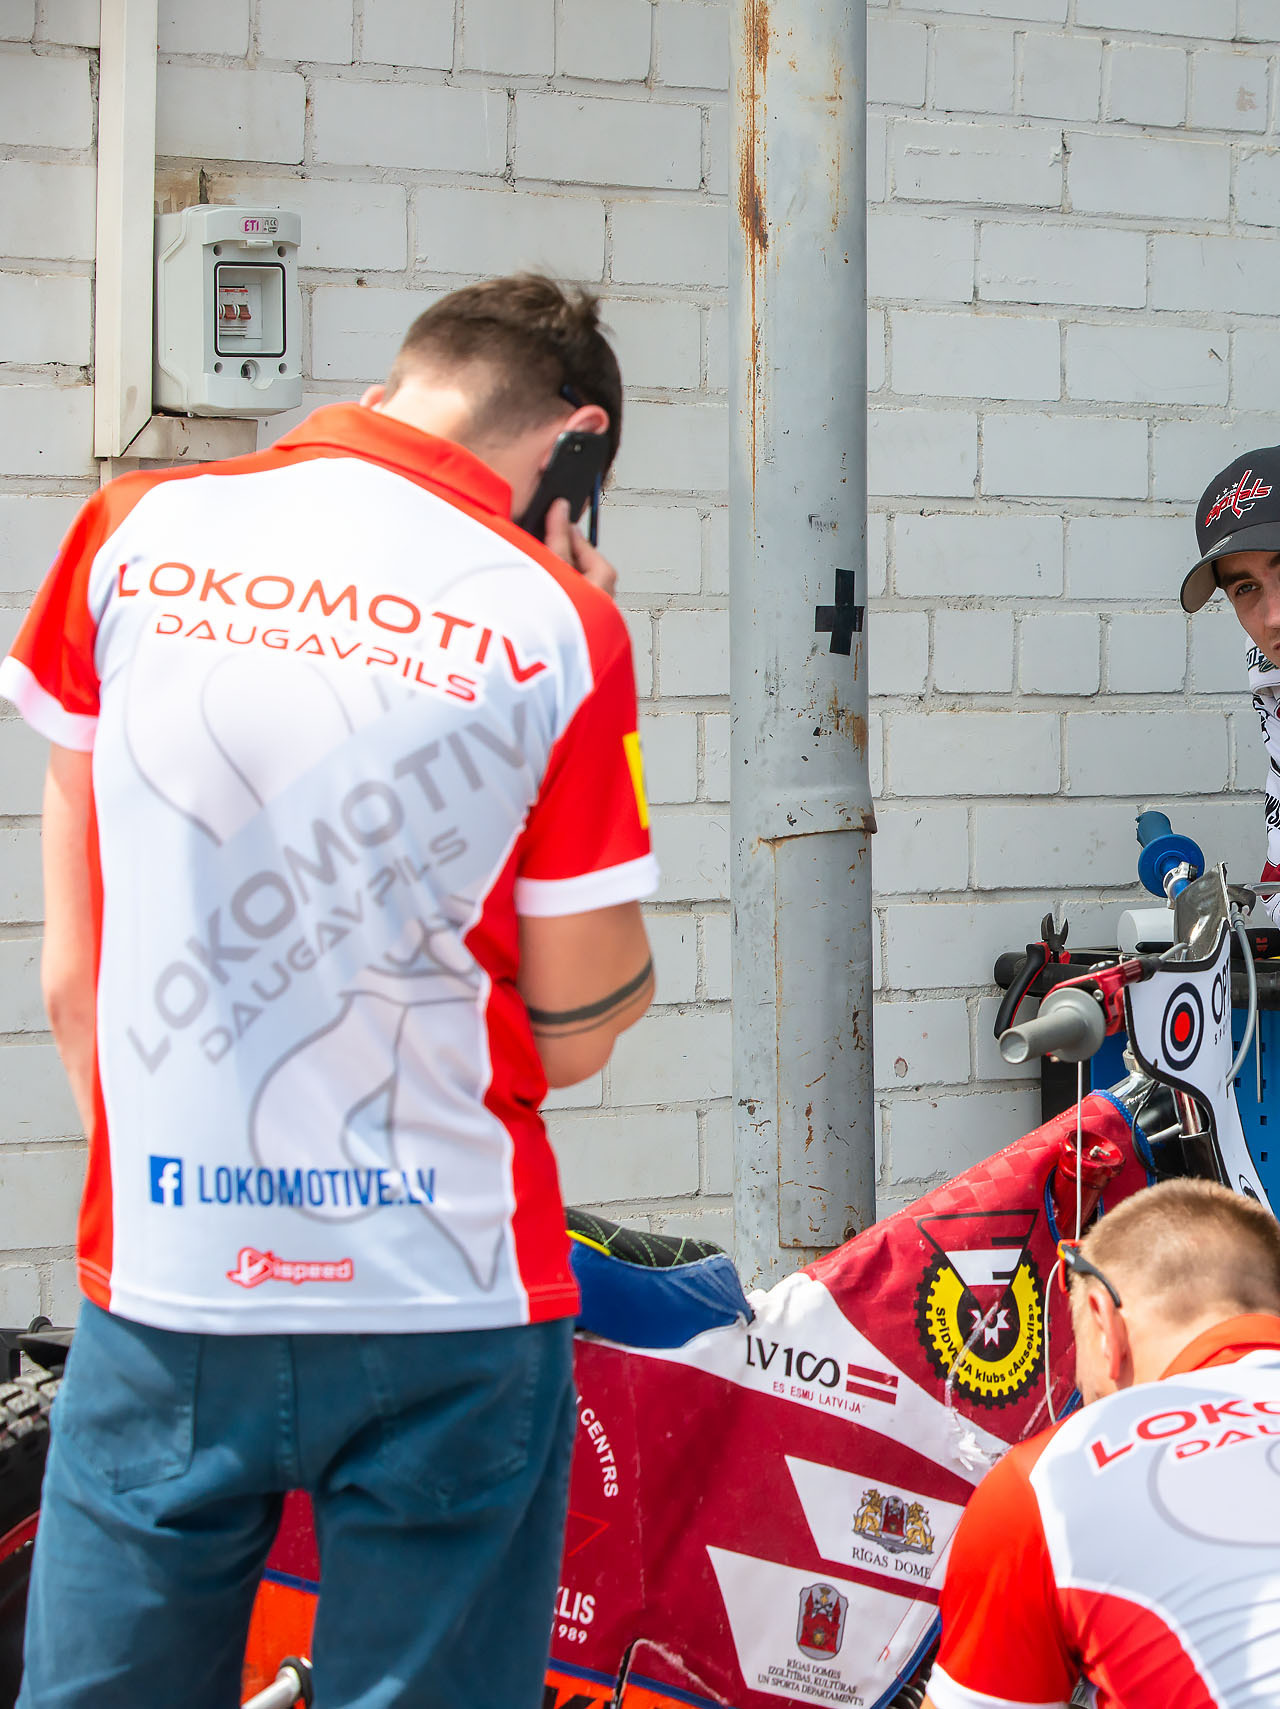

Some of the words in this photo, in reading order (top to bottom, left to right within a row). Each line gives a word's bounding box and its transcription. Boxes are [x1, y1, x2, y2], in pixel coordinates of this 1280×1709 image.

[244, 219, 260, 232] ETI
[118, 561, 548, 684] LOKOMOTIV
[155, 614, 477, 702] DAUGAVPILS
[127, 701, 529, 1076] LOKOMOTIV
[199, 826, 469, 1066] DAUGAVPILS
[773, 1381, 785, 1394] ES
[790, 1386, 814, 1401] ESMU
[819, 1393, 862, 1414] LATVIJA
[975, 1369, 1006, 1384] klubs
[580, 1408, 619, 1498] CENTRS
[894, 1558, 932, 1580] DOME
